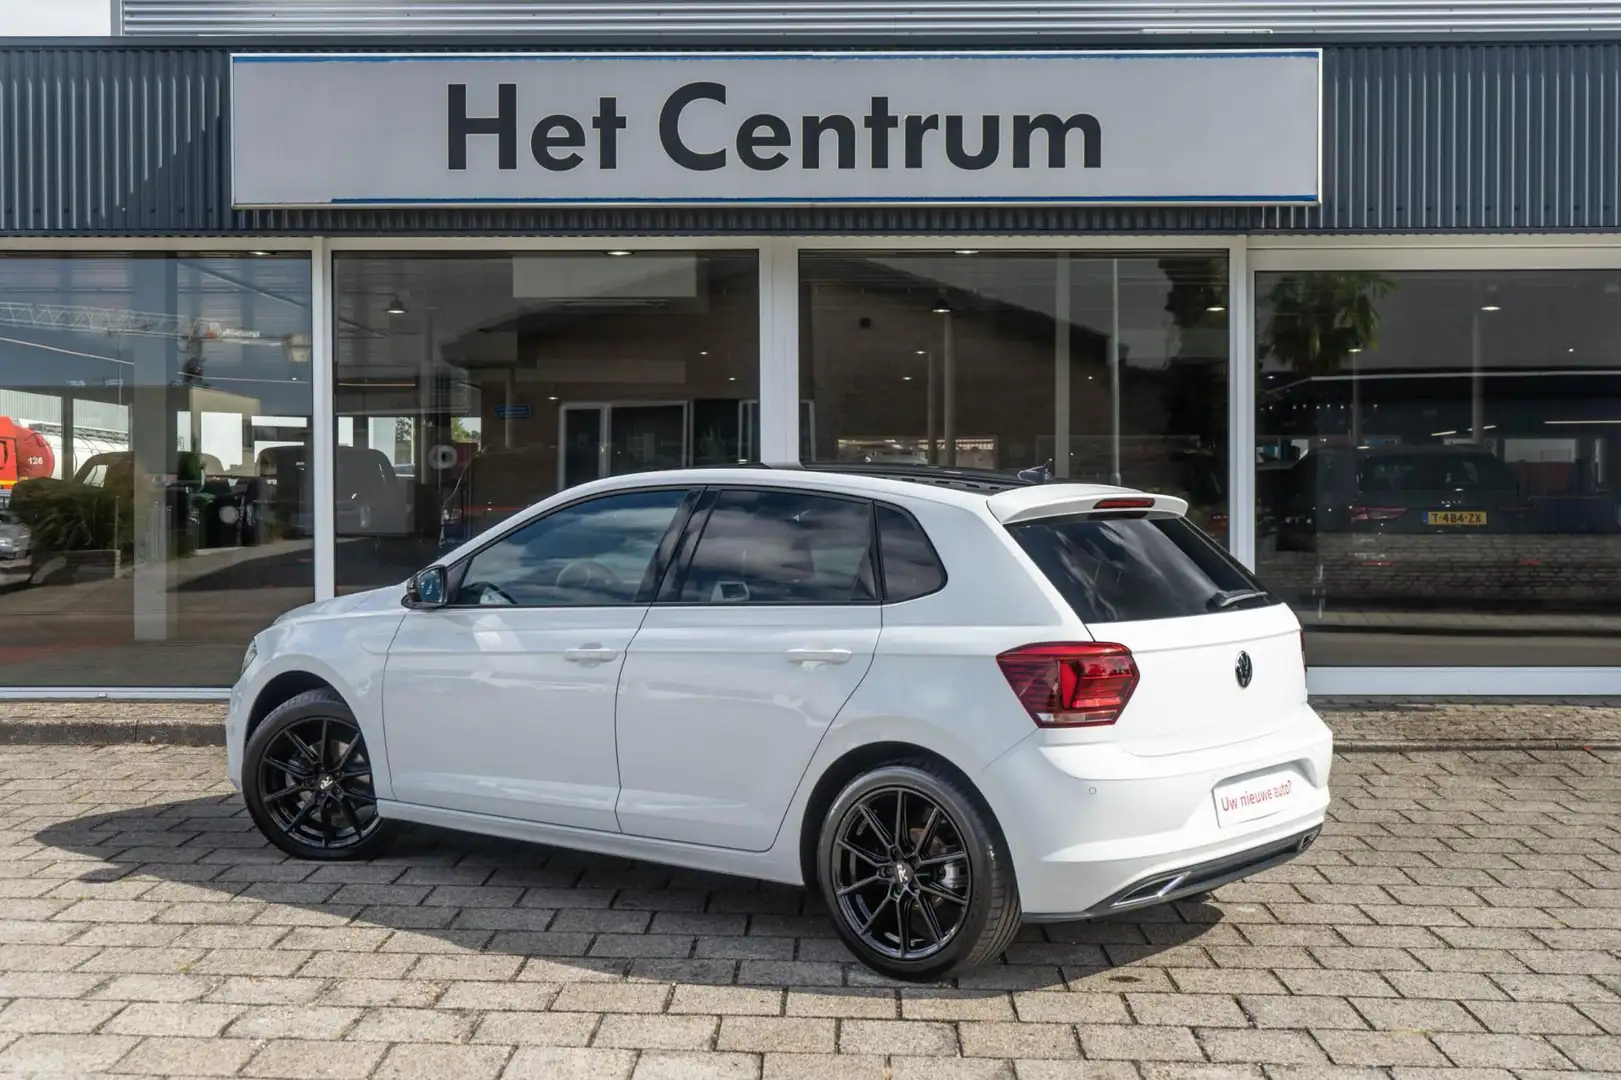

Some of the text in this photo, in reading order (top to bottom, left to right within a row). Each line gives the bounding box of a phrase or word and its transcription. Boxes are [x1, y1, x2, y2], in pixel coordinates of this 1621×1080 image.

[448, 81, 1101, 171] Het Centrum
[1221, 780, 1292, 811] Uw nieuwe auto?
